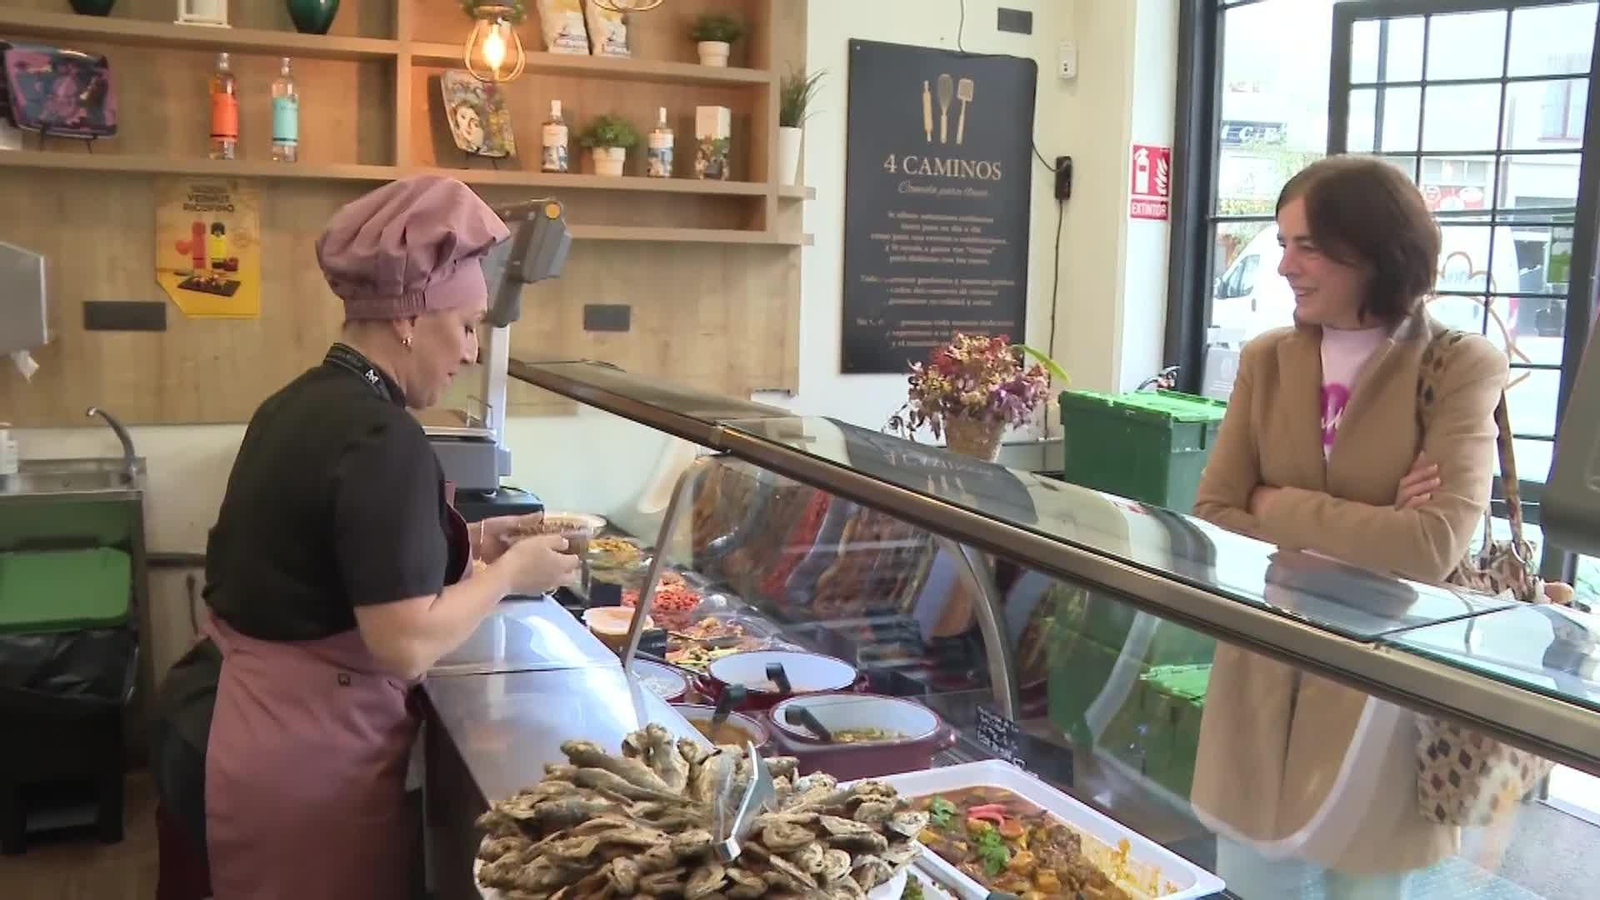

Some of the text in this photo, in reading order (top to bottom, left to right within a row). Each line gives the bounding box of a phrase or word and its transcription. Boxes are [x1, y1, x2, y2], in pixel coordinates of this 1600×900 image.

[883, 153, 1002, 180] 4 CAMINOS
[1131, 202, 1168, 216] EXTINTOR
